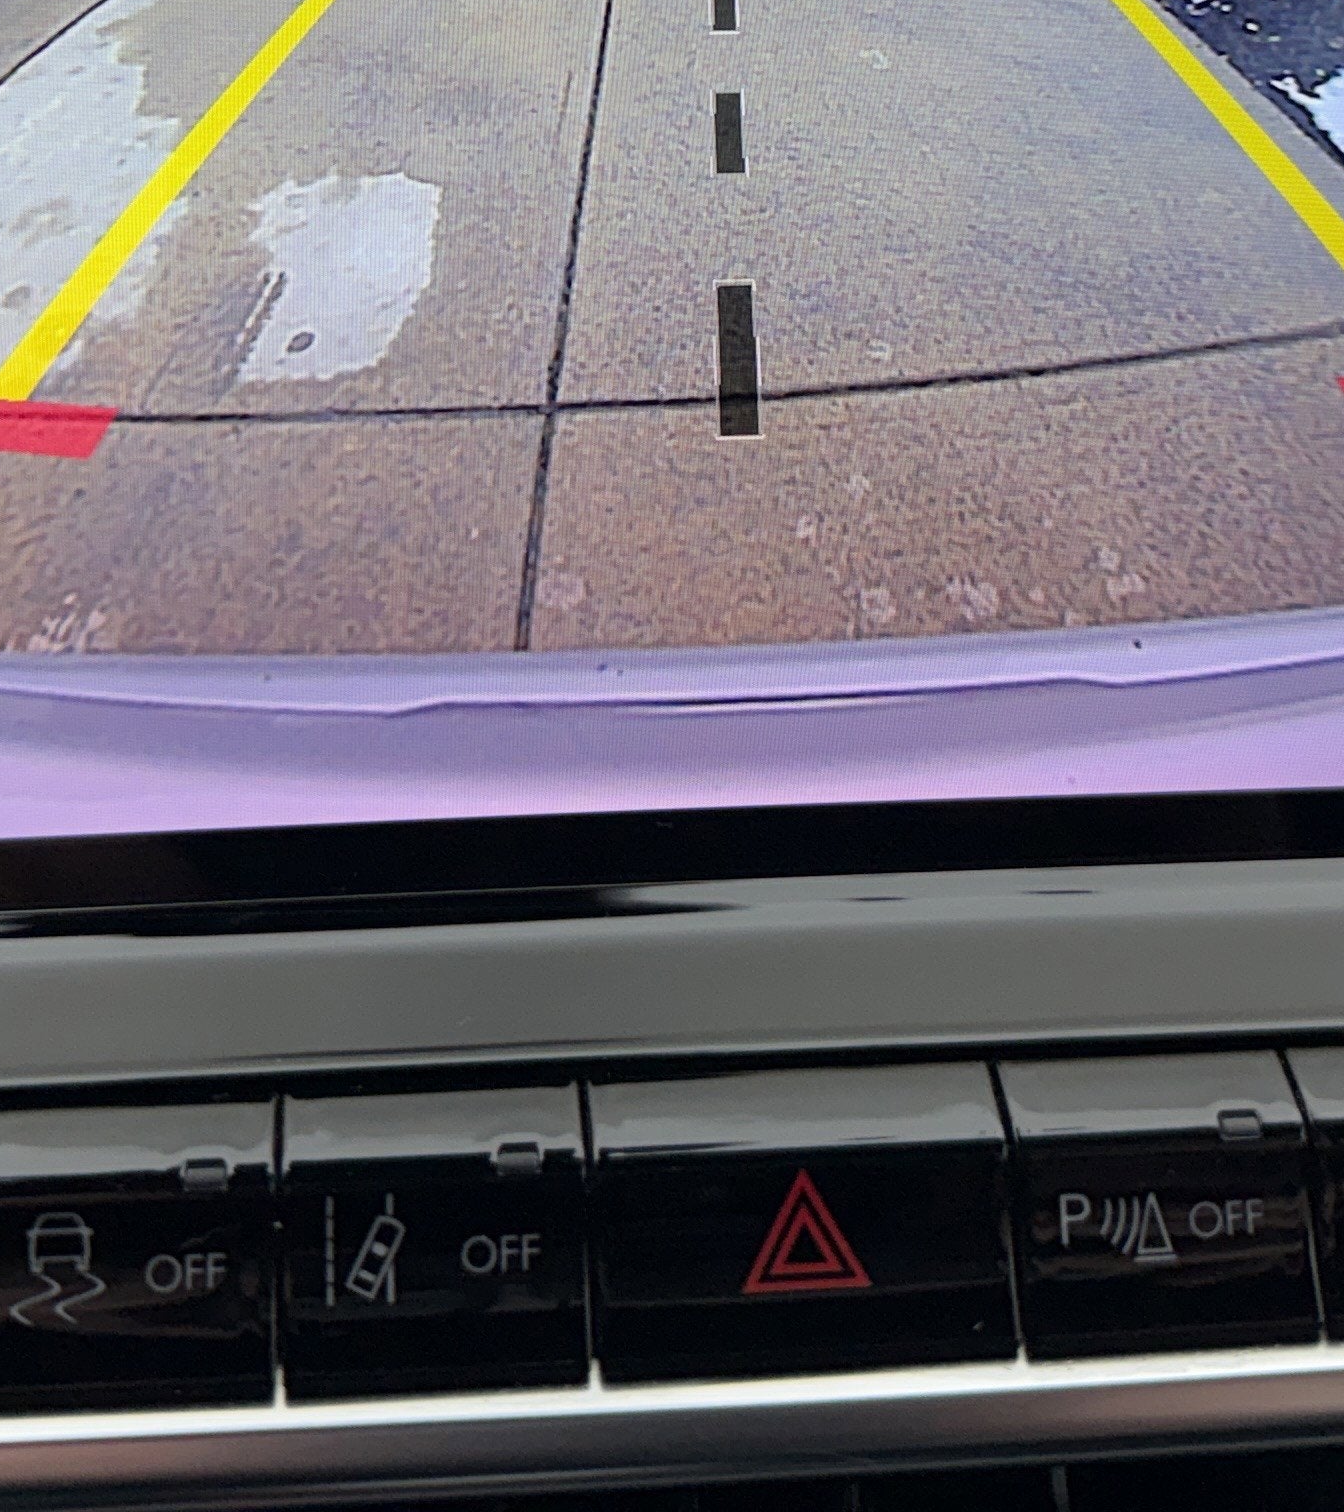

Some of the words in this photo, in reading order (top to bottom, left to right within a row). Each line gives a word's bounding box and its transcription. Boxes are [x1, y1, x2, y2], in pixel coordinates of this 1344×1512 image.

[1189, 1199, 1265, 1238] OFF
[144, 1252, 227, 1293] OFF
[460, 1233, 541, 1273] OFF
